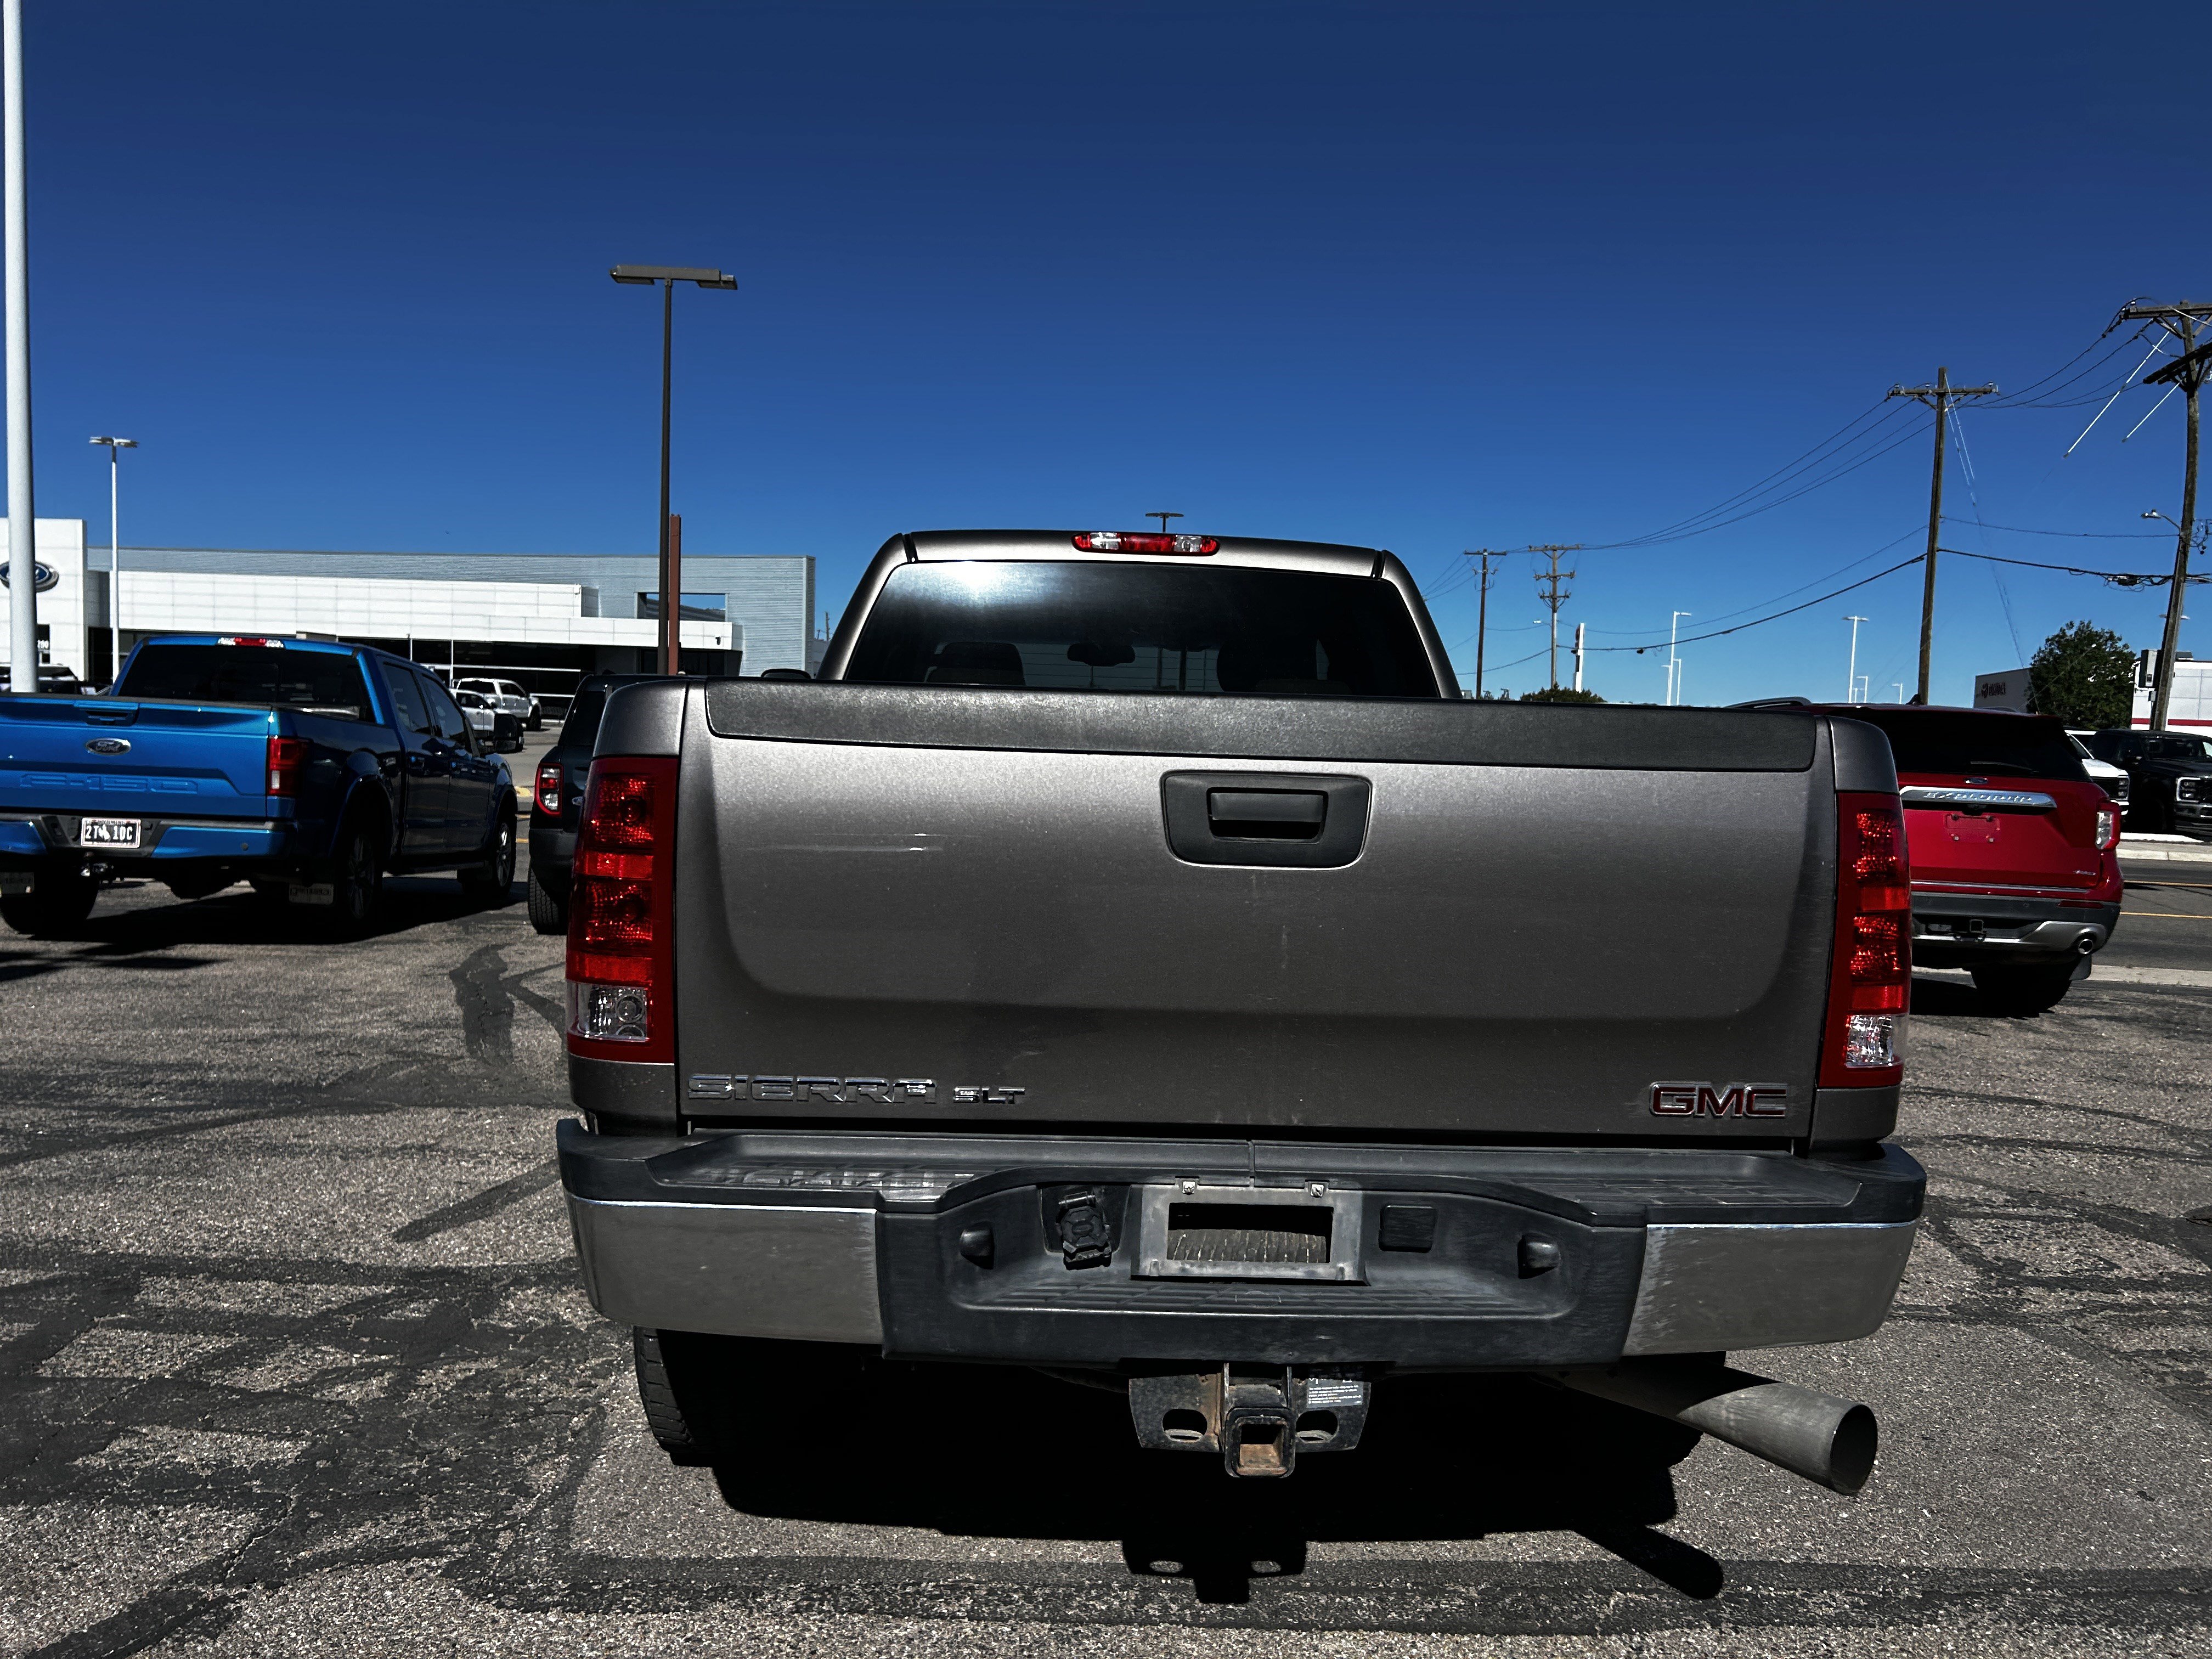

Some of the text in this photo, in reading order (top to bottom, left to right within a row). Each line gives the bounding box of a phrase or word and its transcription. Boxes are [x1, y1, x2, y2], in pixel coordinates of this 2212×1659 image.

[19, 773, 199, 794] F-150
[687, 1074, 1026, 1104] SIERRA SLT
[1650, 1081, 1789, 1118] GMC
